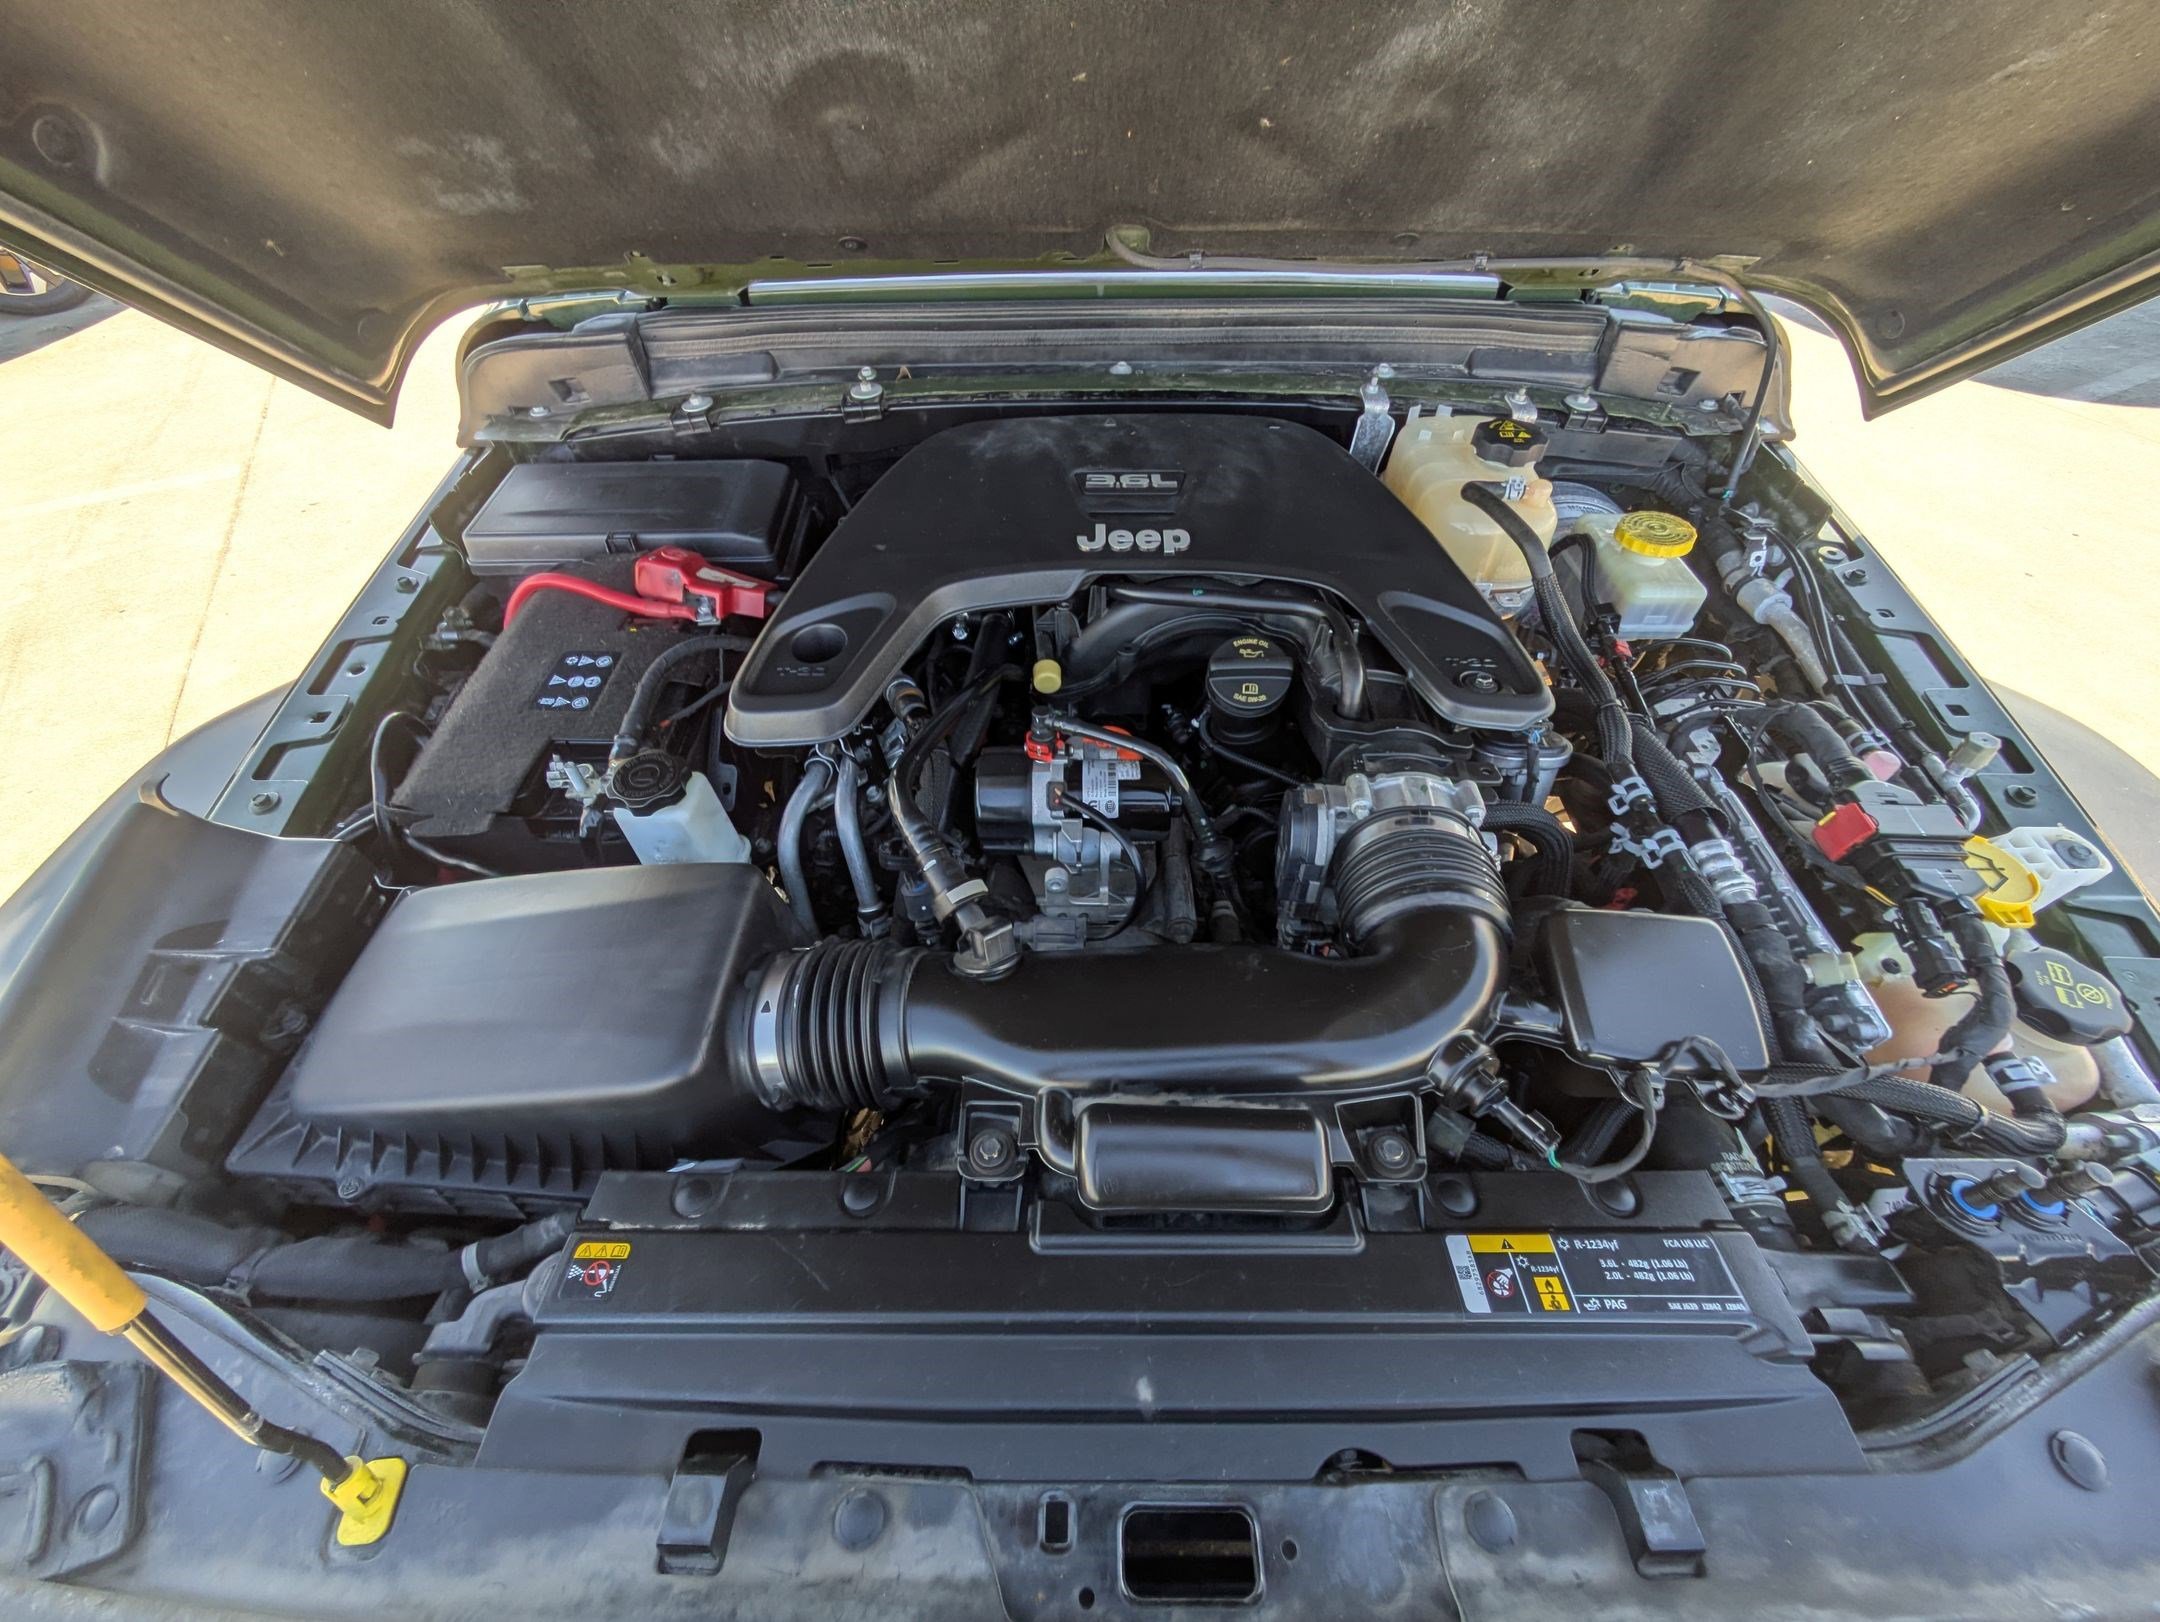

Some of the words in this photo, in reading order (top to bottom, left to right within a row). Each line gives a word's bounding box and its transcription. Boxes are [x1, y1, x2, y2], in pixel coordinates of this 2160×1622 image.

[1085, 474, 1178, 489] 3.6L
[1076, 523, 1191, 556] Jeep
[1573, 1239, 1619, 1251] R-1234yf
[1662, 1239, 1681, 1248] FCA
[1682, 1239, 1694, 1248] US
[1694, 1239, 1710, 1248] LLC
[1600, 1259, 1619, 1268] 3.6L
[1628, 1259, 1650, 1270] 482g
[1605, 1271, 1624, 1280] 2.0L
[1633, 1271, 1656, 1282] 482g
[1604, 1299, 1627, 1309] PAG
